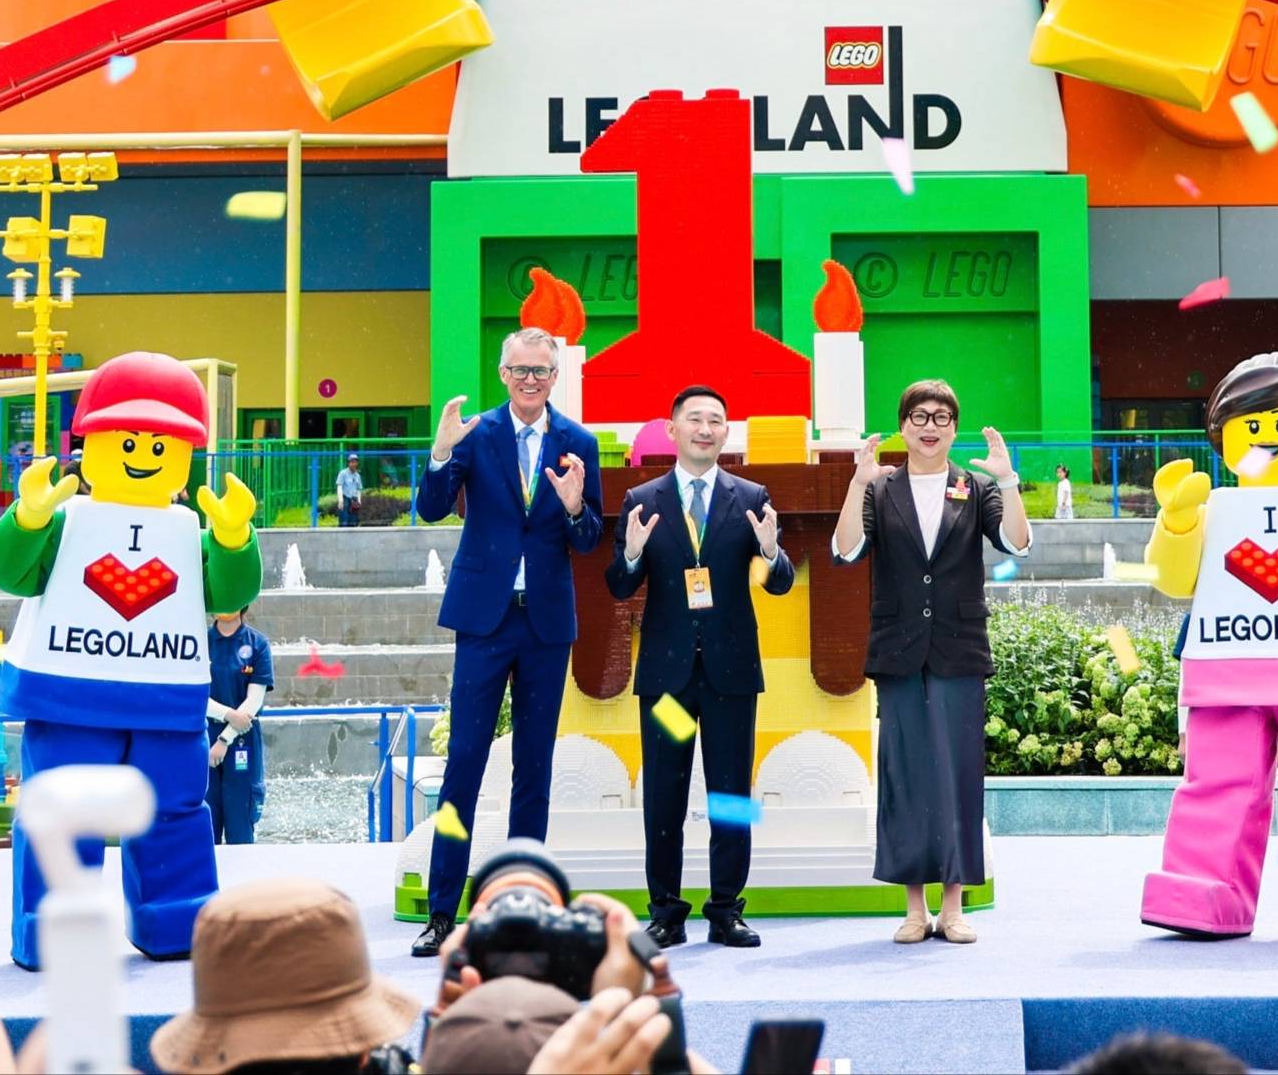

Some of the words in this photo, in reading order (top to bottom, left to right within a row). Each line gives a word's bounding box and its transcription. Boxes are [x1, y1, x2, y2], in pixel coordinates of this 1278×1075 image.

[828, 42, 881, 68] LEGO
[548, 26, 963, 153] LELAND
[579, 253, 638, 302] LEG
[922, 250, 1013, 297] LEGO
[128, 525, 143, 551] I
[1263, 506, 1277, 533] I
